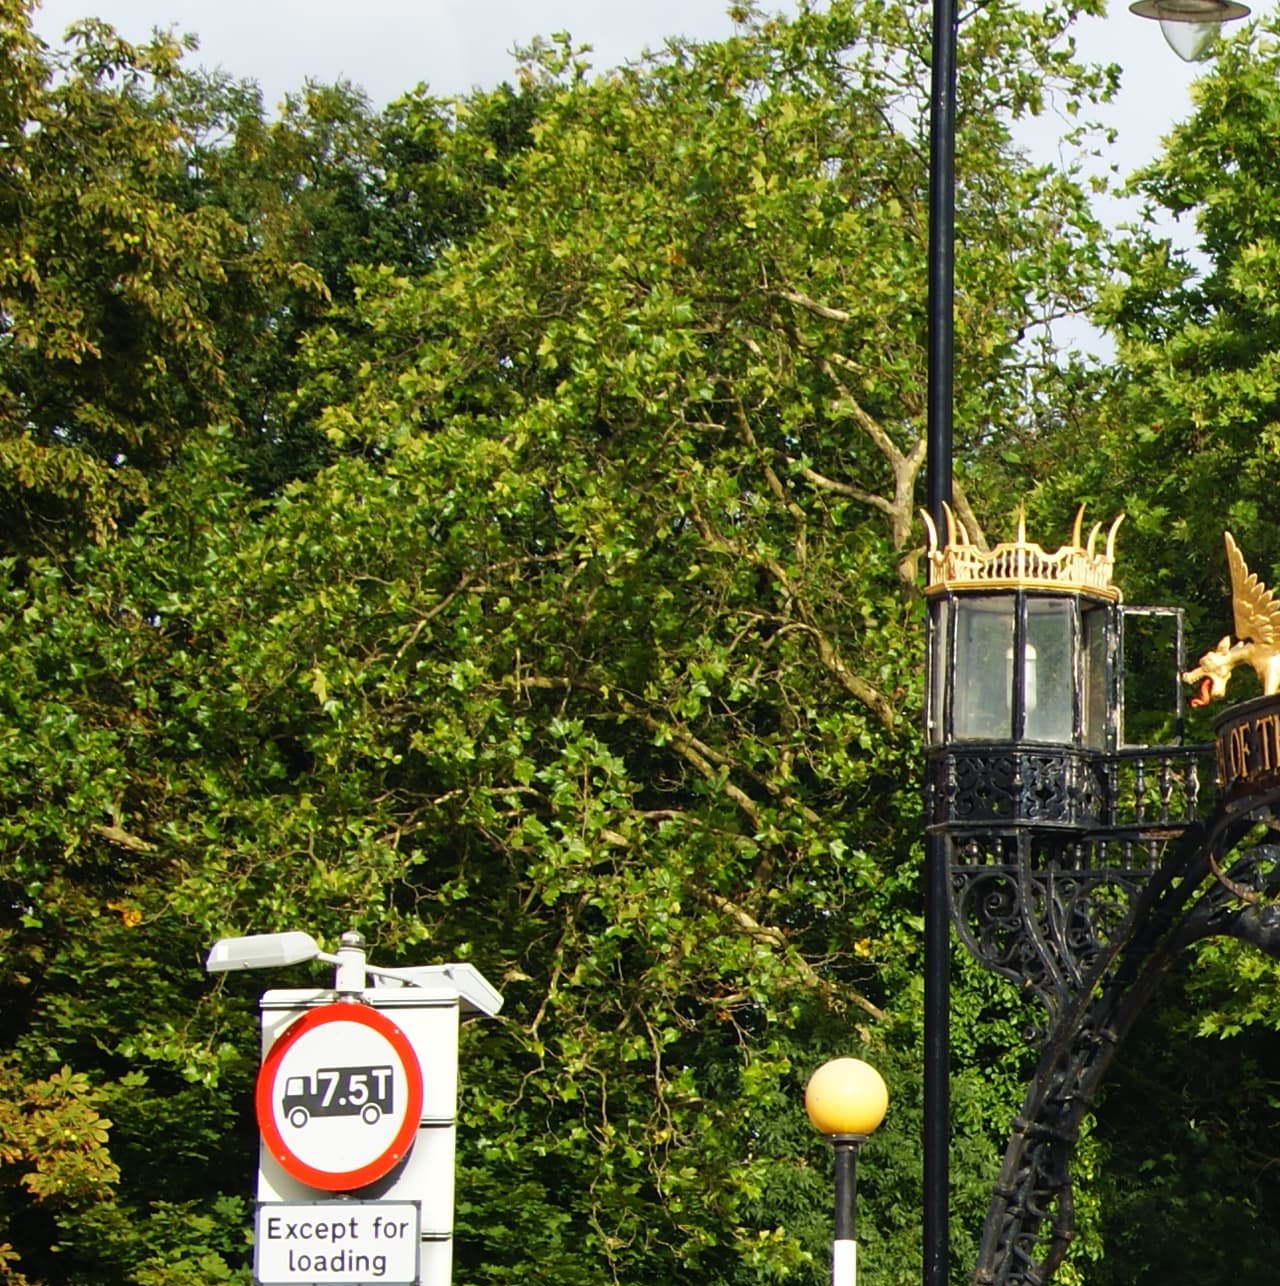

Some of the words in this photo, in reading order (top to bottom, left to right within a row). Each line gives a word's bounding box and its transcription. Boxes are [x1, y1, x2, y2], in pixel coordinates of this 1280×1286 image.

[1230, 721, 1250, 778] OF
[317, 1068, 393, 1108] 7.5T
[267, 1217, 359, 1243] Except
[373, 1217, 409, 1239] for
[289, 1249, 387, 1276] loading
